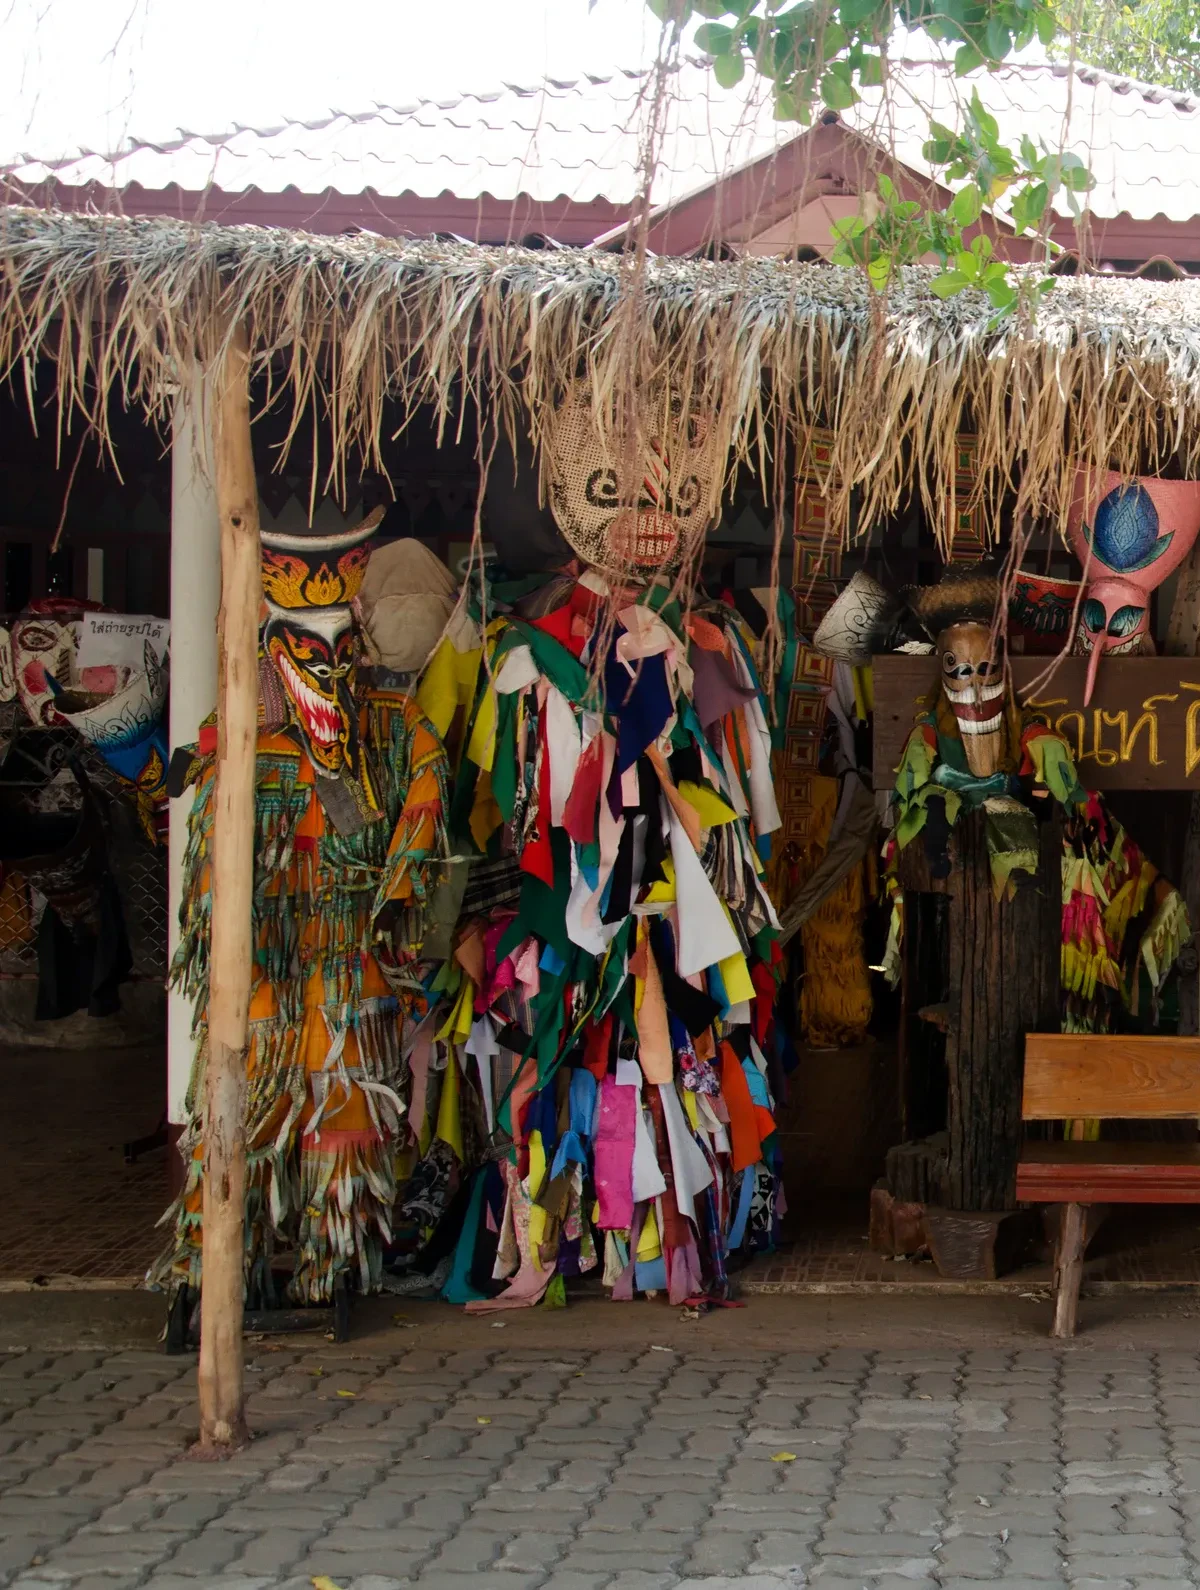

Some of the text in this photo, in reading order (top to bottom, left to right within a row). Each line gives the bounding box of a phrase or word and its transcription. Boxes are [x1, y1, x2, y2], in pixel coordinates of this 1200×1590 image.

[90, 620, 165, 639] ใส่ถ่ายรูปได้
